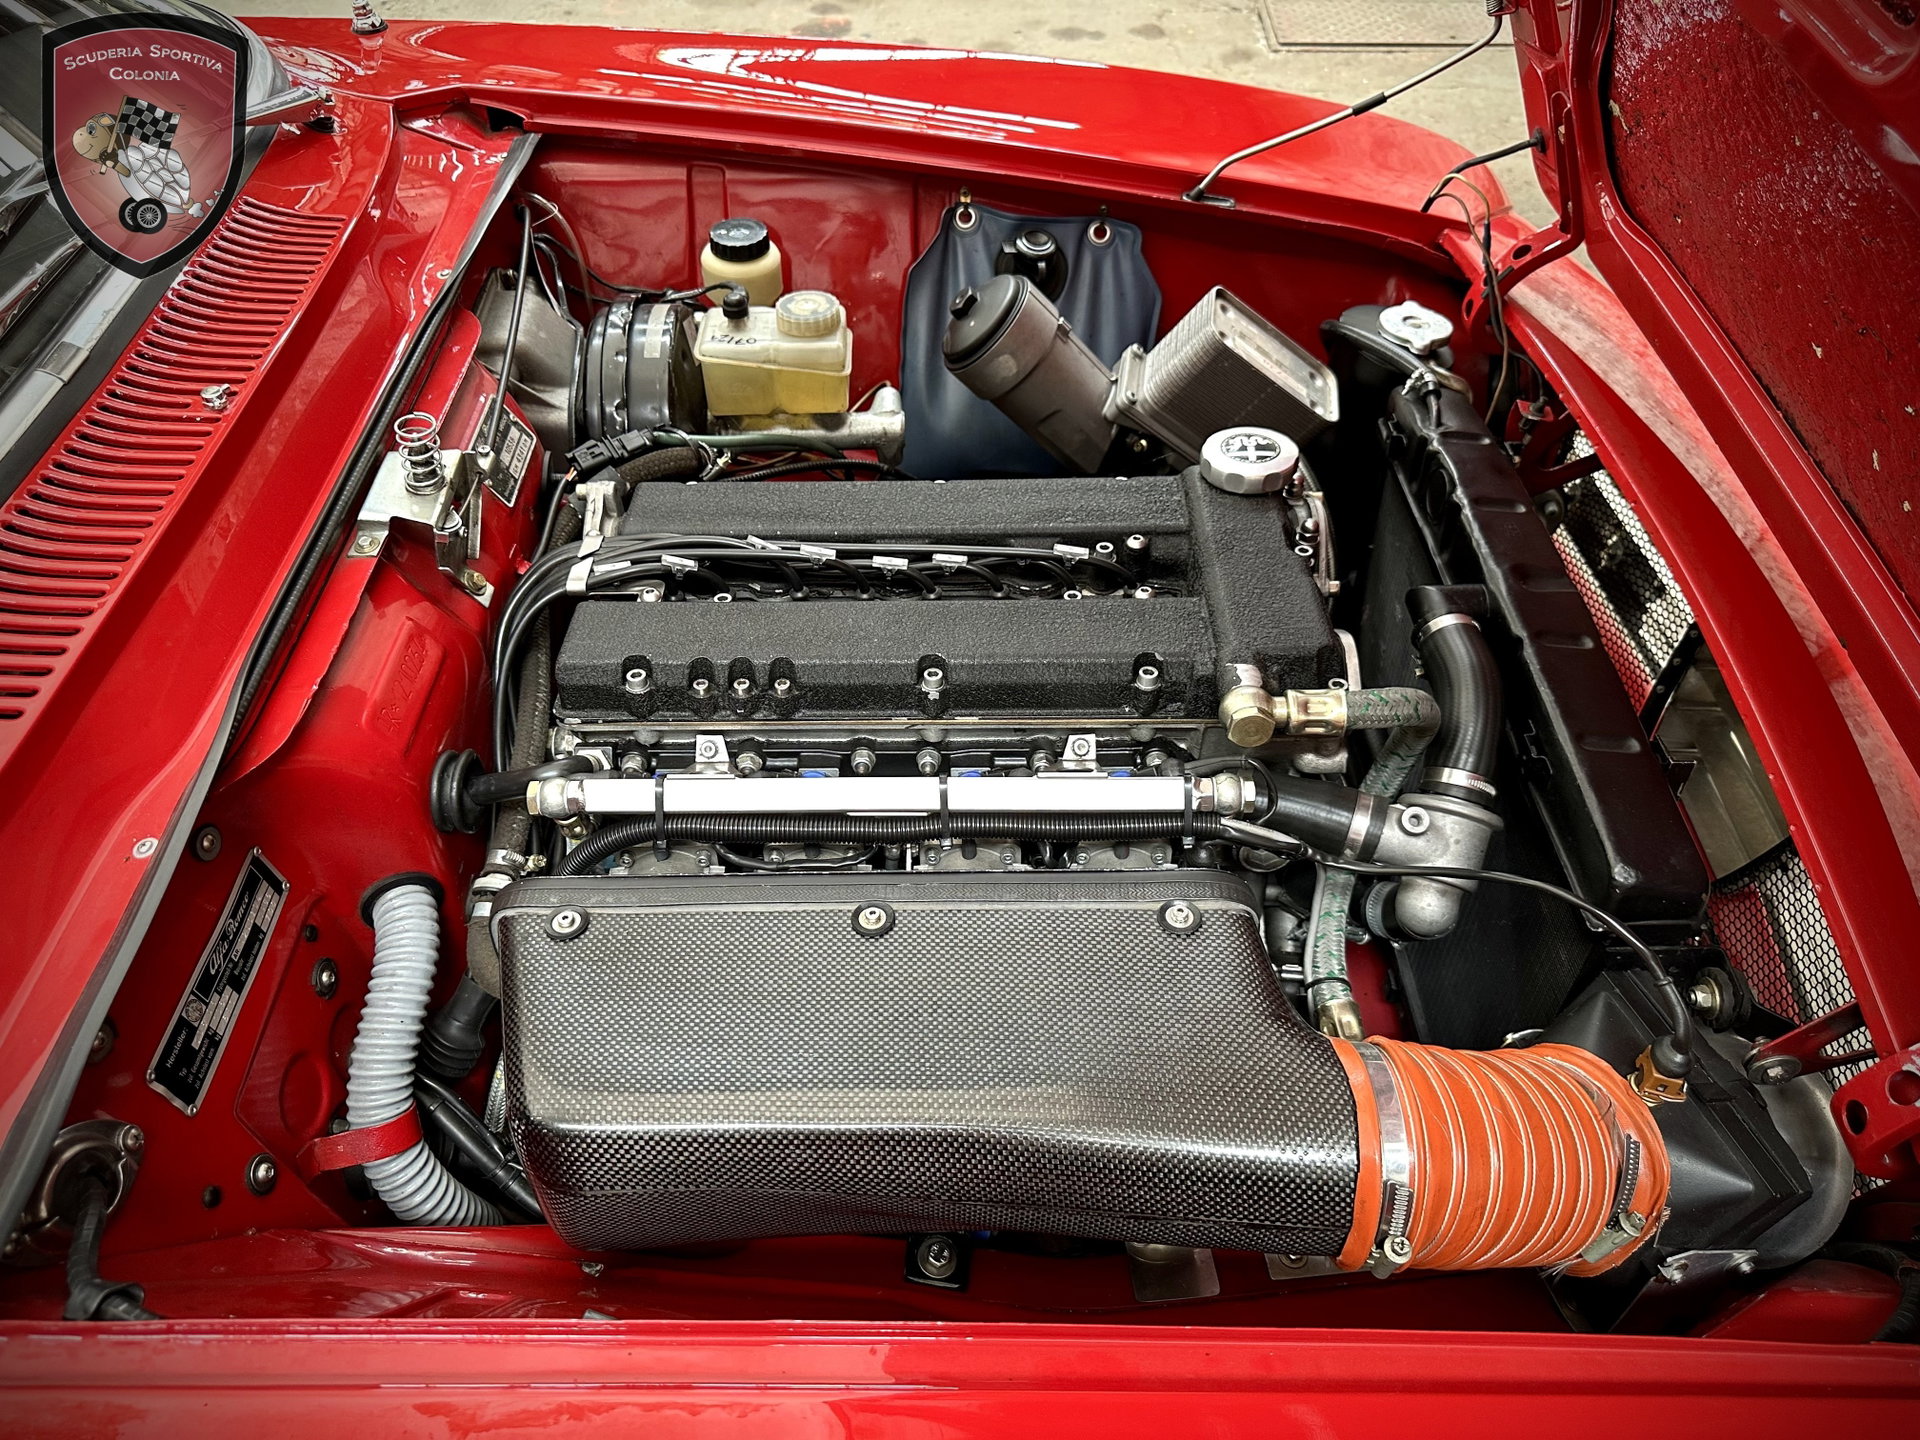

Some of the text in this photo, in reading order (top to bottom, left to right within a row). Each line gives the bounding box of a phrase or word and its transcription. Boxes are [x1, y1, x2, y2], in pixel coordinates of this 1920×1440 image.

[208, 937, 232, 976] Alfa
[224, 891, 250, 941] Romeo
[164, 1024, 189, 1070] Hersteller:
